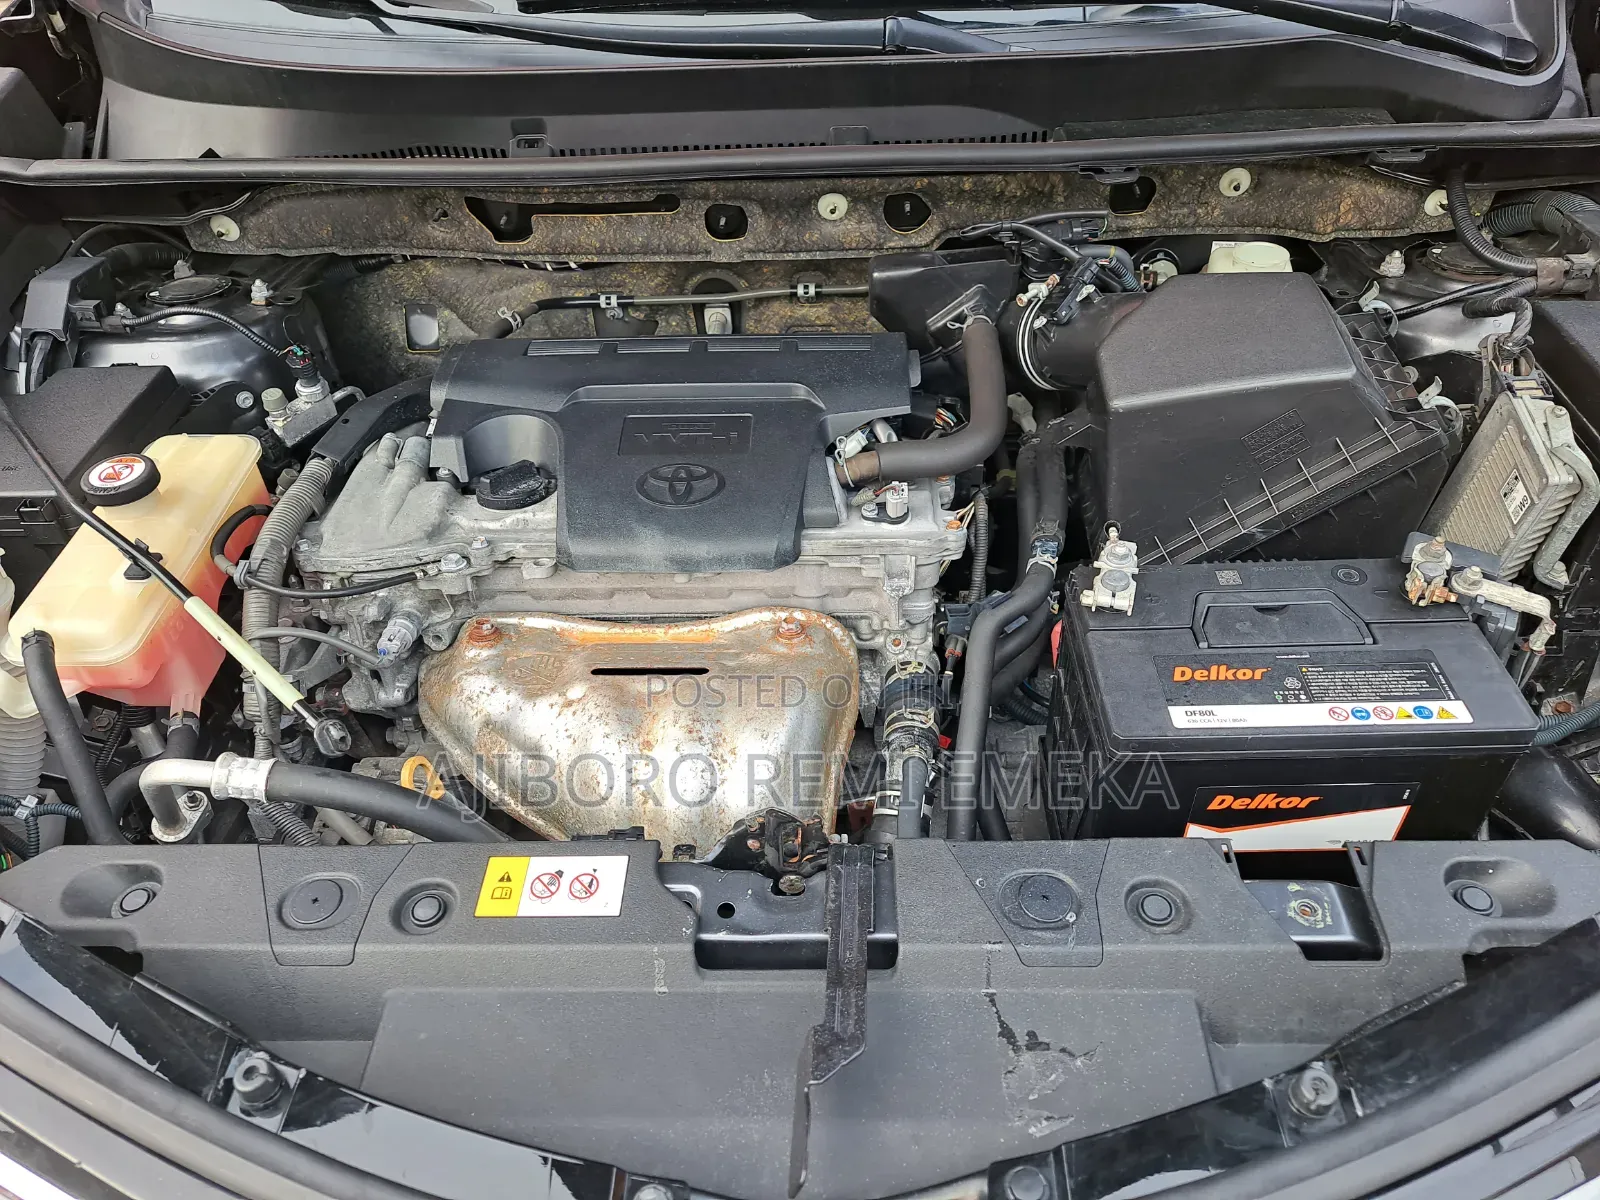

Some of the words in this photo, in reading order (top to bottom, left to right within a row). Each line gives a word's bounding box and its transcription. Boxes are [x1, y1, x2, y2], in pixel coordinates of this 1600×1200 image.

[1173, 664, 1269, 681] Delkor
[1185, 709, 1217, 718] DF80L
[1206, 793, 1321, 810] Delkor
